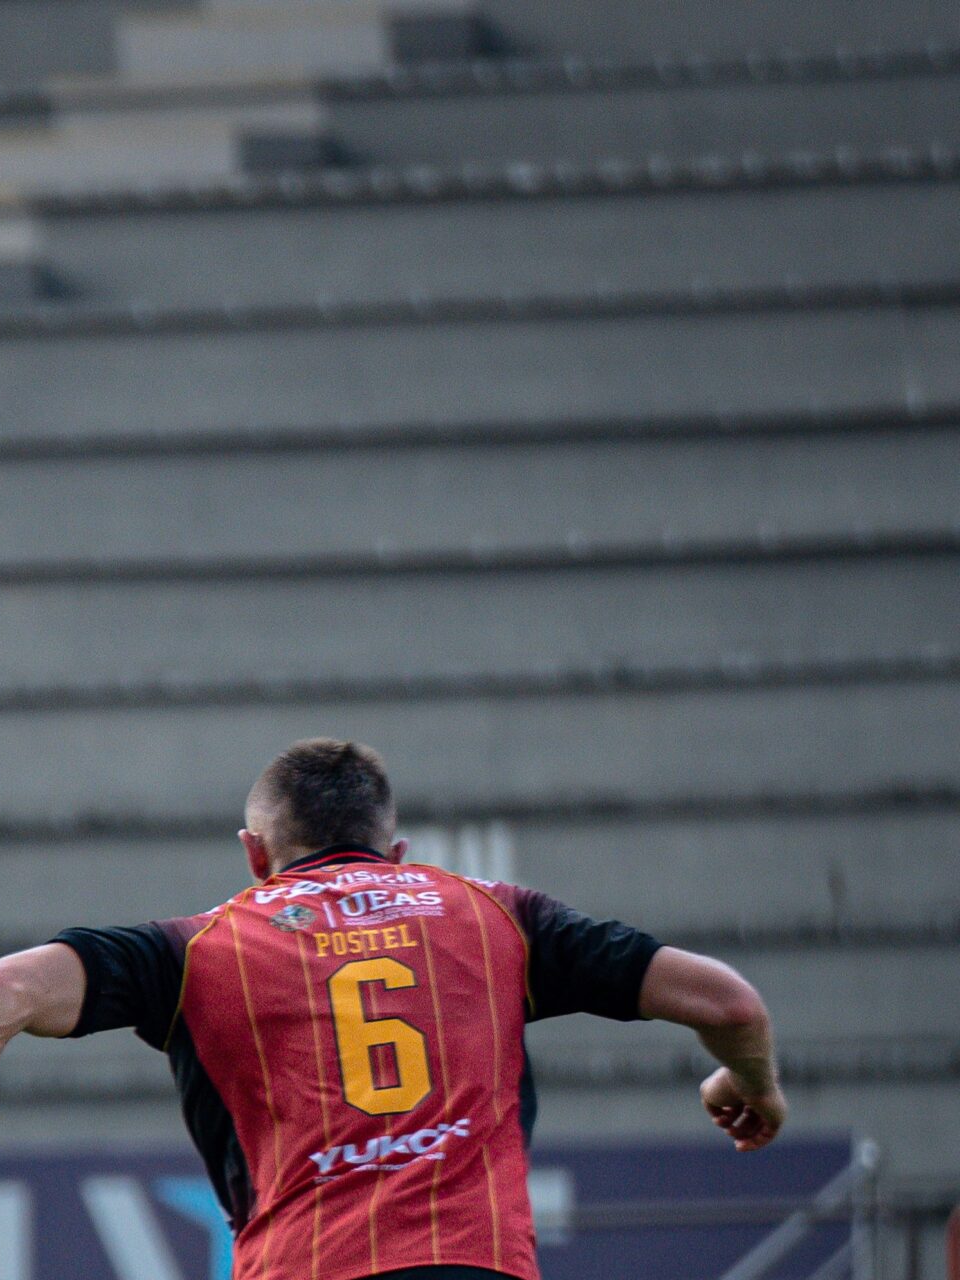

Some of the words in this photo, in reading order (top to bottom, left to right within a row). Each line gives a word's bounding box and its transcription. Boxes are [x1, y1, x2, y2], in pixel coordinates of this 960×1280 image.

[337, 890, 443, 917] UEAS
[314, 924, 418, 957] POSTEL
[327, 956, 432, 1117] 6
